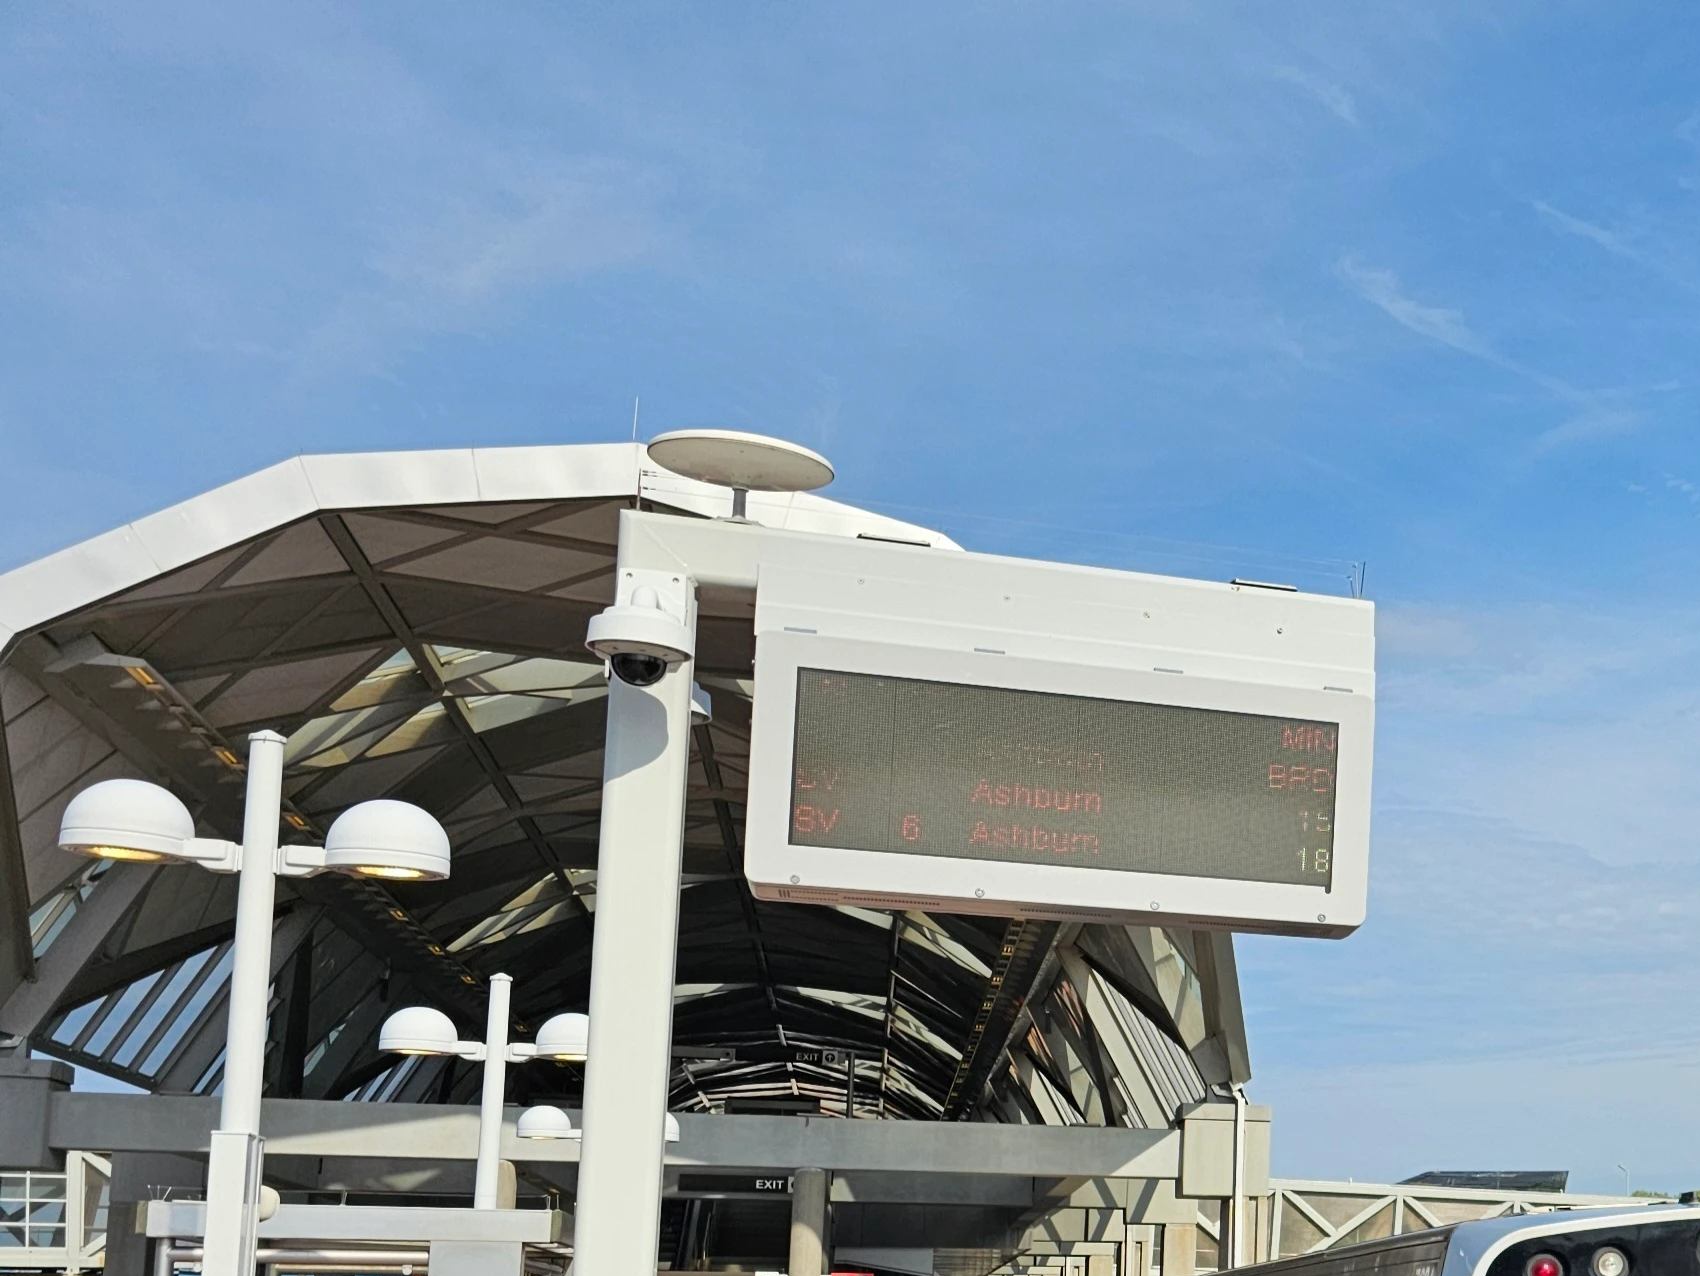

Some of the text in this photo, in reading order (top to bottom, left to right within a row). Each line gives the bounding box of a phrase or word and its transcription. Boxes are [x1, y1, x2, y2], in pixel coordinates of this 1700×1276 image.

[902, 814, 920, 841] 6
[969, 820, 1099, 854] Ashburn
[1299, 847, 1329, 872] 18
[796, 1053, 819, 1061] EXIT
[756, 1180, 784, 1189] EXIT
